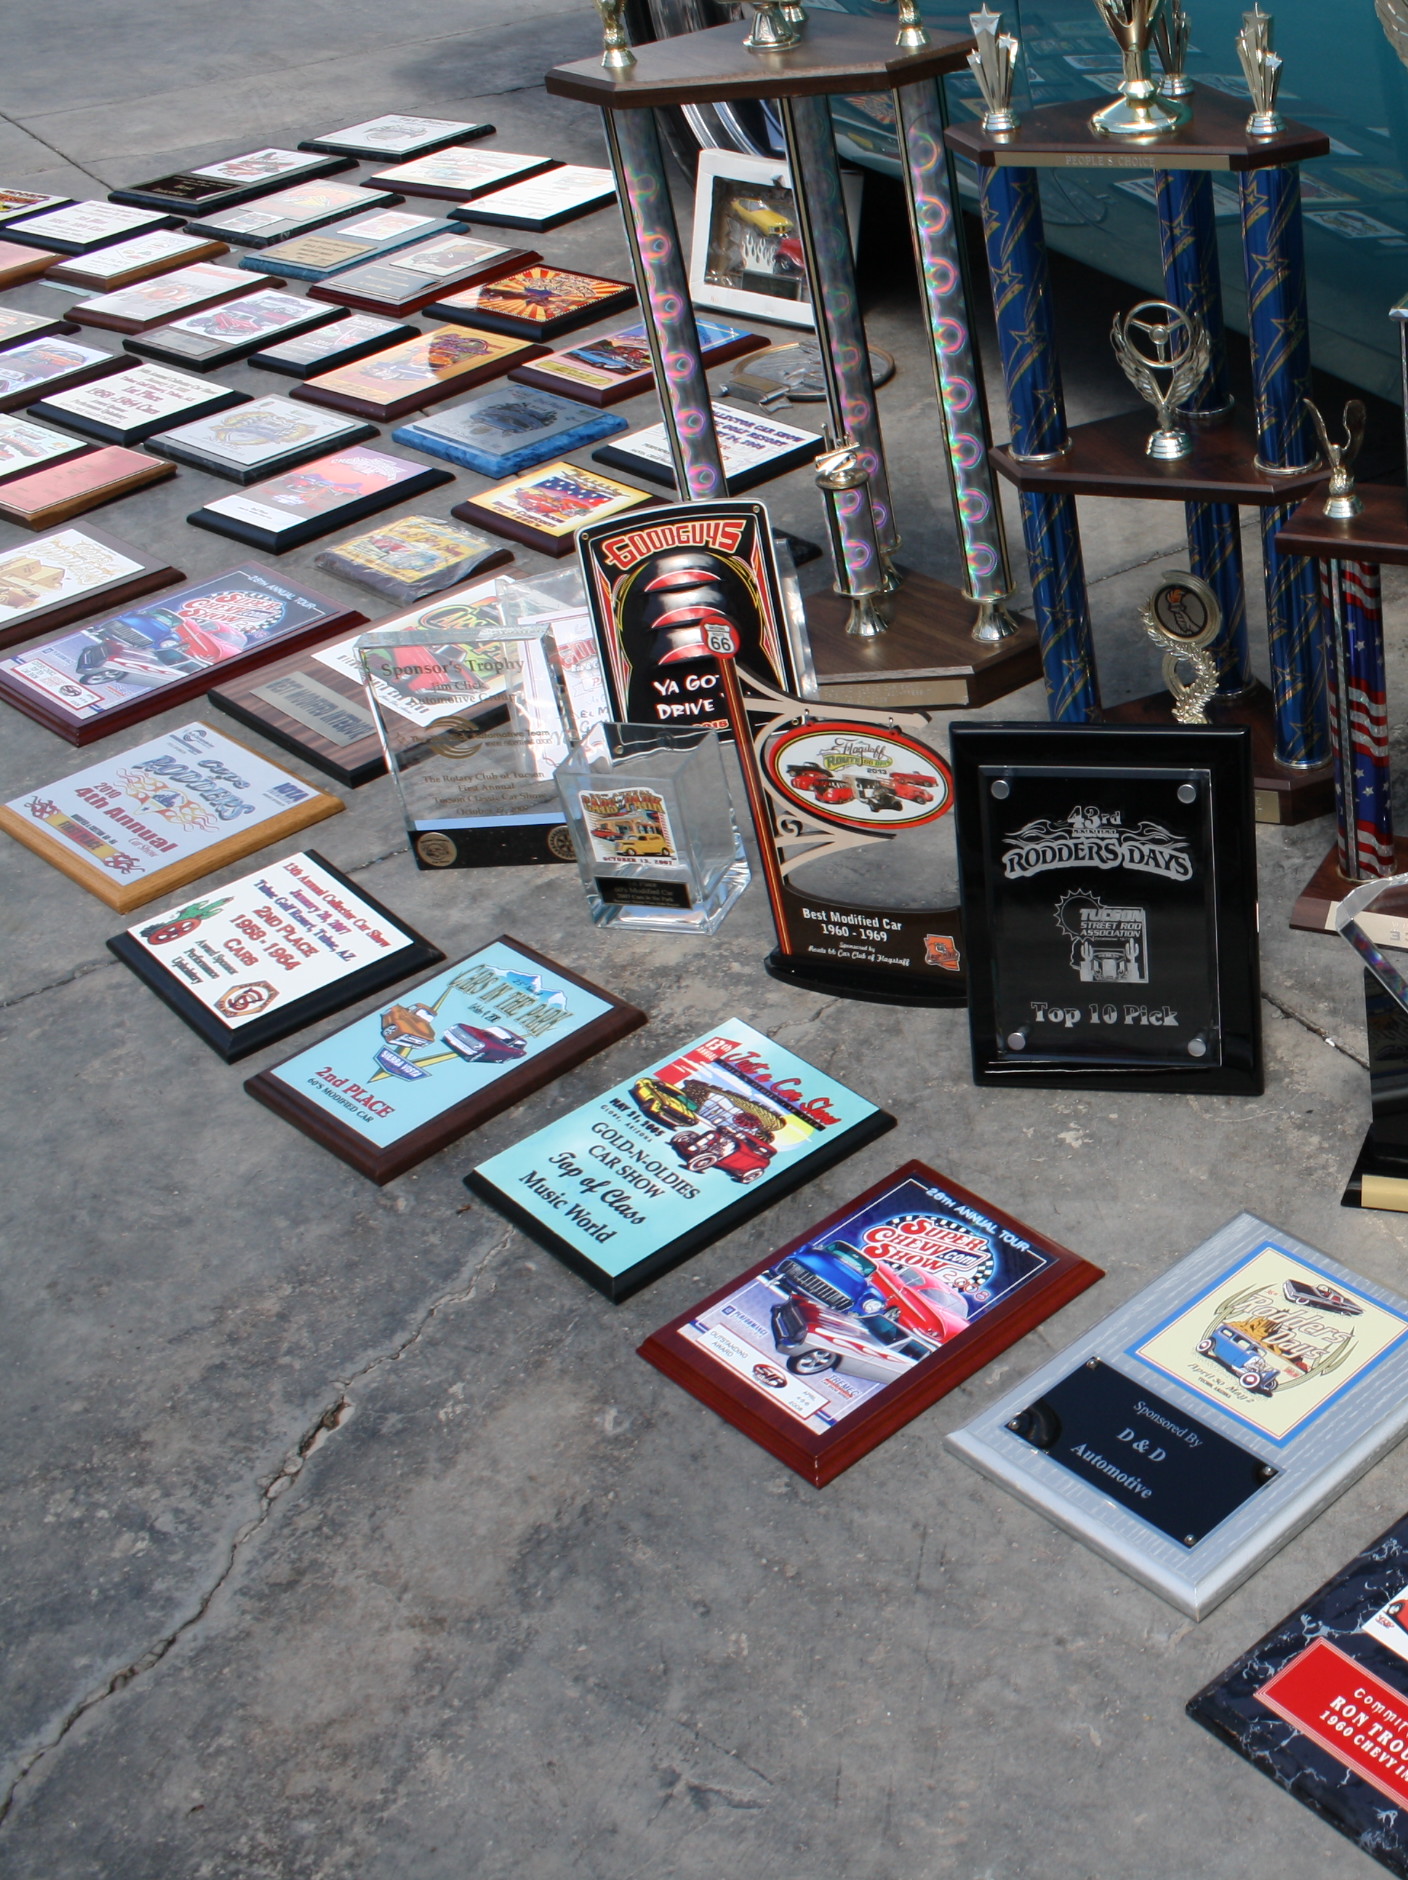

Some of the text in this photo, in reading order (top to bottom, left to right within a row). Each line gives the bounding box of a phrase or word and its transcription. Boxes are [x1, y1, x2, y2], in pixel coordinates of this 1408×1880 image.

[601, 520, 747, 571] GOODGUYS
[267, 583, 317, 610] ANNUAL TOUR
[381, 661, 462, 679] Sponsor's
[468, 657, 524, 675] Trophy
[653, 678, 679, 698] YA
[656, 698, 715, 720] DRIVE
[131, 754, 256, 821] RODDERS
[74, 786, 110, 810] 4th
[103, 806, 180, 853] Annual
[1067, 805, 1121, 829] 43rd
[1003, 839, 1192, 881] RODDERS DAYS
[252, 905, 320, 958] 2ND PLACE
[322, 893, 392, 948] Collector Show
[802, 907, 902, 931] Best Modified Car
[821, 923, 887, 941] 1960 1969
[1080, 929, 1141, 938] ASSOCIATION
[222, 938, 259, 966] CARS
[230, 914, 302, 971] 1958 1964
[447, 964, 495, 997] CARS
[480, 981, 509, 1008] IN
[493, 989, 535, 1019] THE
[522, 1001, 575, 1038] PARK
[1031, 1001, 1179, 1028] Top 10 Pick
[315, 1066, 395, 1120] 2nd PLACE
[322, 1087, 375, 1124] MODIFIED CAR
[770, 1077, 842, 1126] Car Show
[609, 1097, 666, 1138] MAY 2005
[588, 1144, 665, 1200] CAR SHOW
[591, 1121, 702, 1200] GOLD-N-OLDIES
[548, 1151, 648, 1225] Top of Class
[519, 1170, 617, 1245] Music World
[900, 1219, 988, 1251] SUPER
[953, 1205, 1030, 1252] ANNUAL TOUR
[862, 1244, 951, 1271] SHOW
[1231, 1293, 1354, 1345] Rodders
[710, 1330, 748, 1359] OUTSTANDING
[711, 1340, 734, 1357] AWARD
[1273, 1327, 1330, 1361] Days
[1133, 1399, 1204, 1448] Sponsored By
[1116, 1428, 1167, 1464] D & D
[1070, 1442, 1154, 1500] Automotive
[1329, 1695, 1371, 1728] RON
[1318, 1710, 1355, 1738] 1960
[1352, 1733, 1398, 1768] CHEVY
